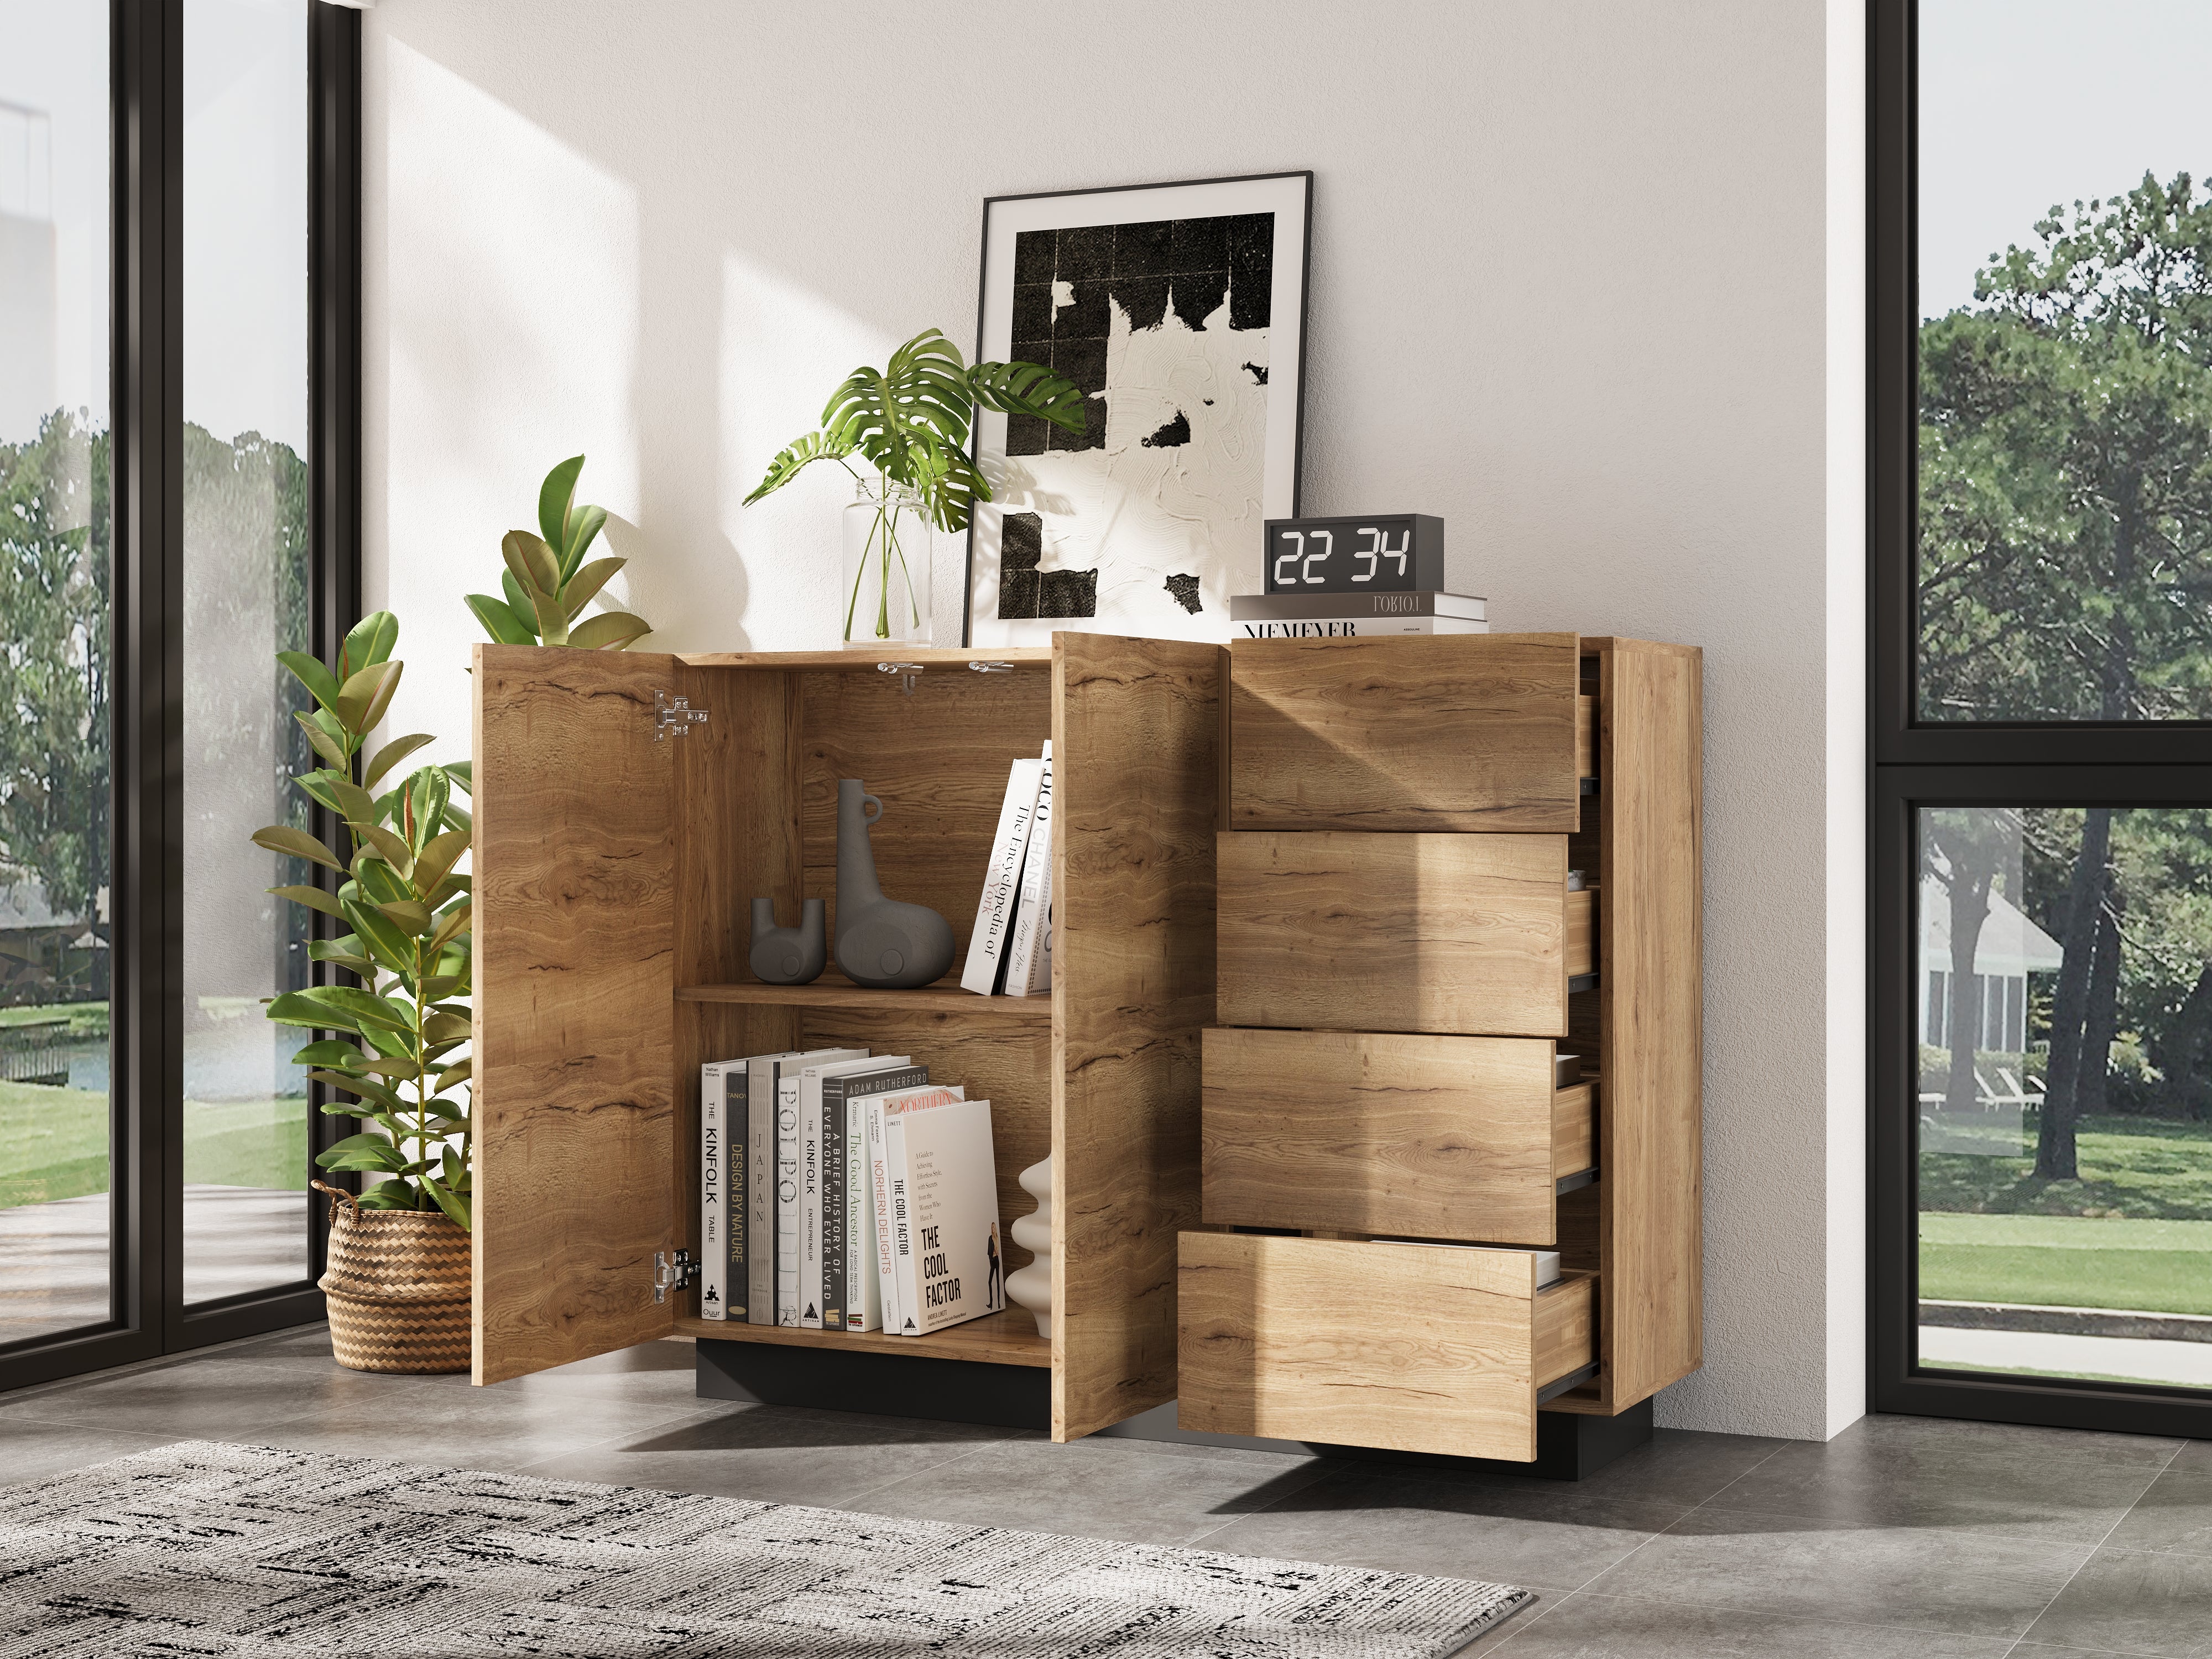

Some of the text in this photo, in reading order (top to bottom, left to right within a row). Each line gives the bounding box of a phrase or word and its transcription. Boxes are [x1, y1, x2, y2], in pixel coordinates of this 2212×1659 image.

[1274, 528, 1410, 585] 22 34
[1244, 622, 1355, 638] NIEMEYER
[982, 842, 1009, 916] New York
[984, 805, 1030, 959] The Encyclopedia of
[1021, 828, 1046, 909] CHANEL
[849, 1073, 927, 1095] ADAM RUTHERFORD
[706, 1128, 717, 1204] KINFOLK
[807, 1140, 815, 1194] KINFOLK
[851, 1133, 861, 1246] The Good Ancestor
[916, 1161, 932, 1170] Achieving
[917, 1172, 933, 1180] Effortless
[732, 1144, 743, 1263] DESIGN BY NATURE
[874, 1160, 891, 1274] NORHERN DELIGHTS
[894, 1179, 909, 1255] THE COOL FACTOR
[921, 1225, 940, 1251] THE
[833, 1259, 840, 1275] OF
[924, 1253, 949, 1280] COOL
[926, 1277, 962, 1308] FACTOR
[927, 1312, 937, 1321] ANDREA
